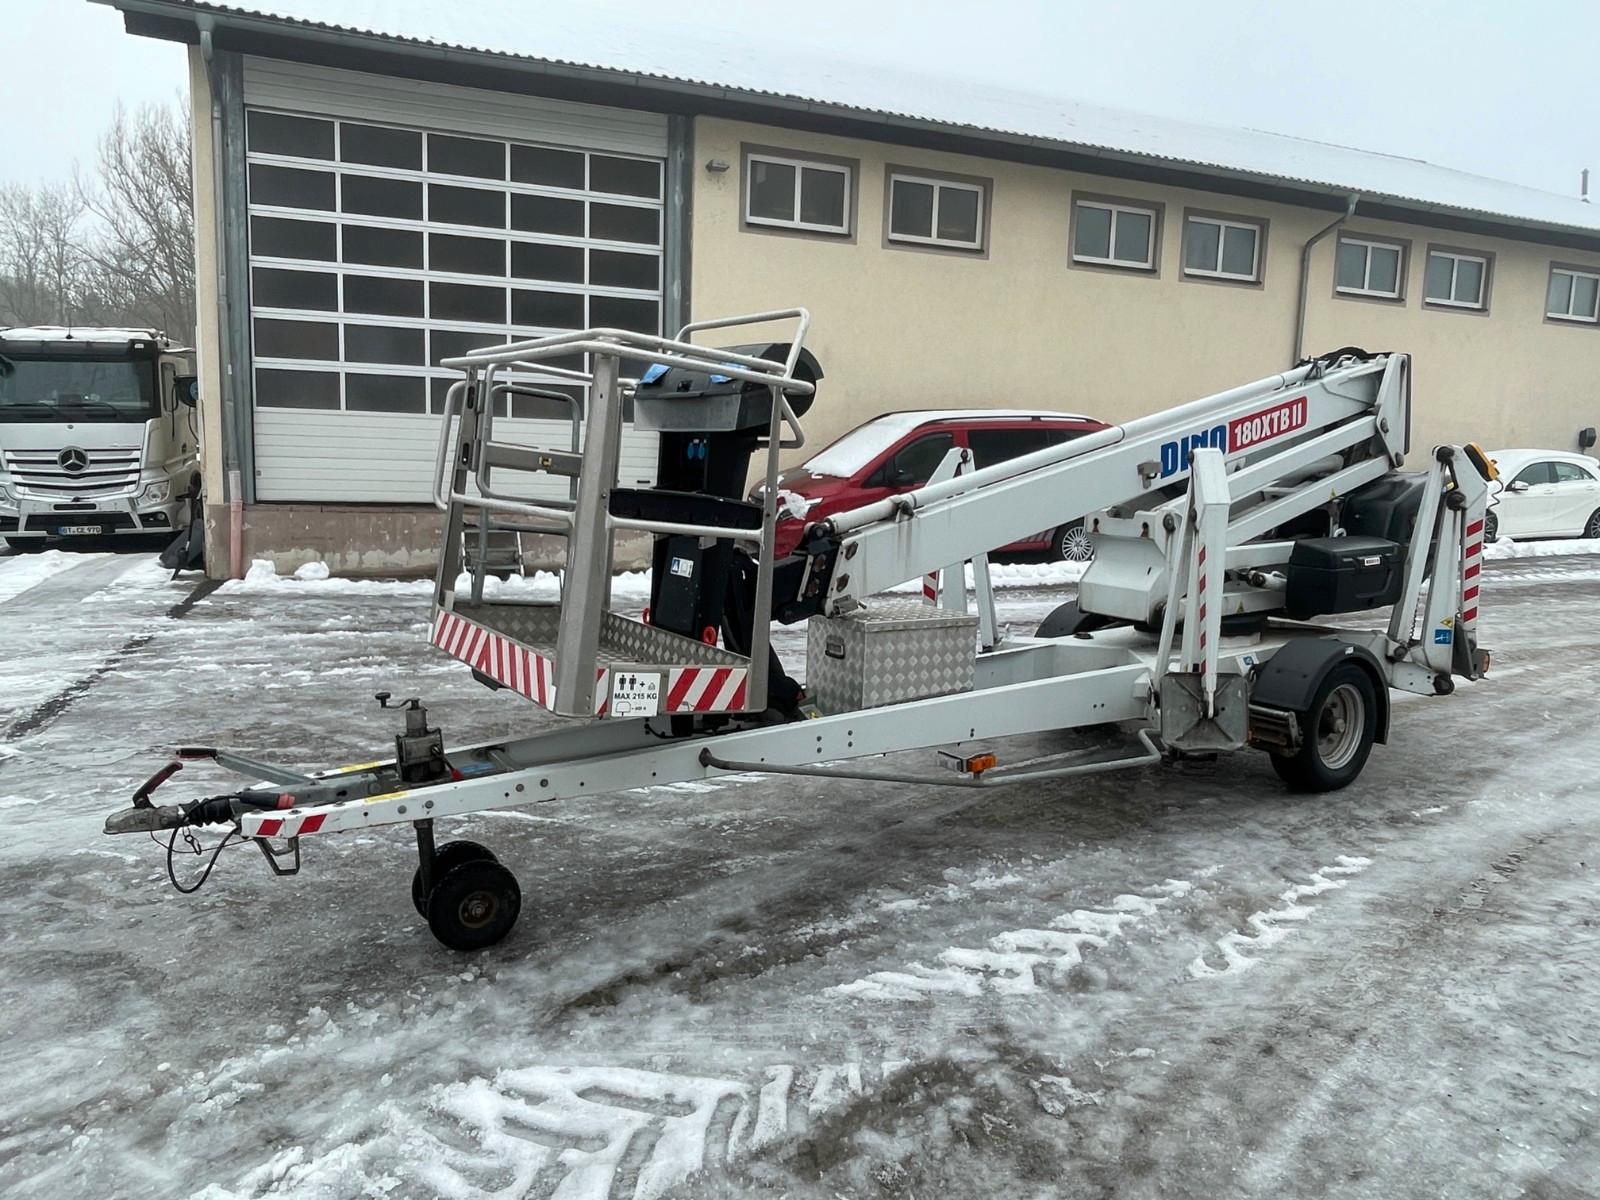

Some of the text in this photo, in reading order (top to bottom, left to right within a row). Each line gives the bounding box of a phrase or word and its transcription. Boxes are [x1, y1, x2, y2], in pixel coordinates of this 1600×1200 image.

[1234, 407, 1290, 448] 180XTB
[614, 692, 657, 700] MAX 215 KG
